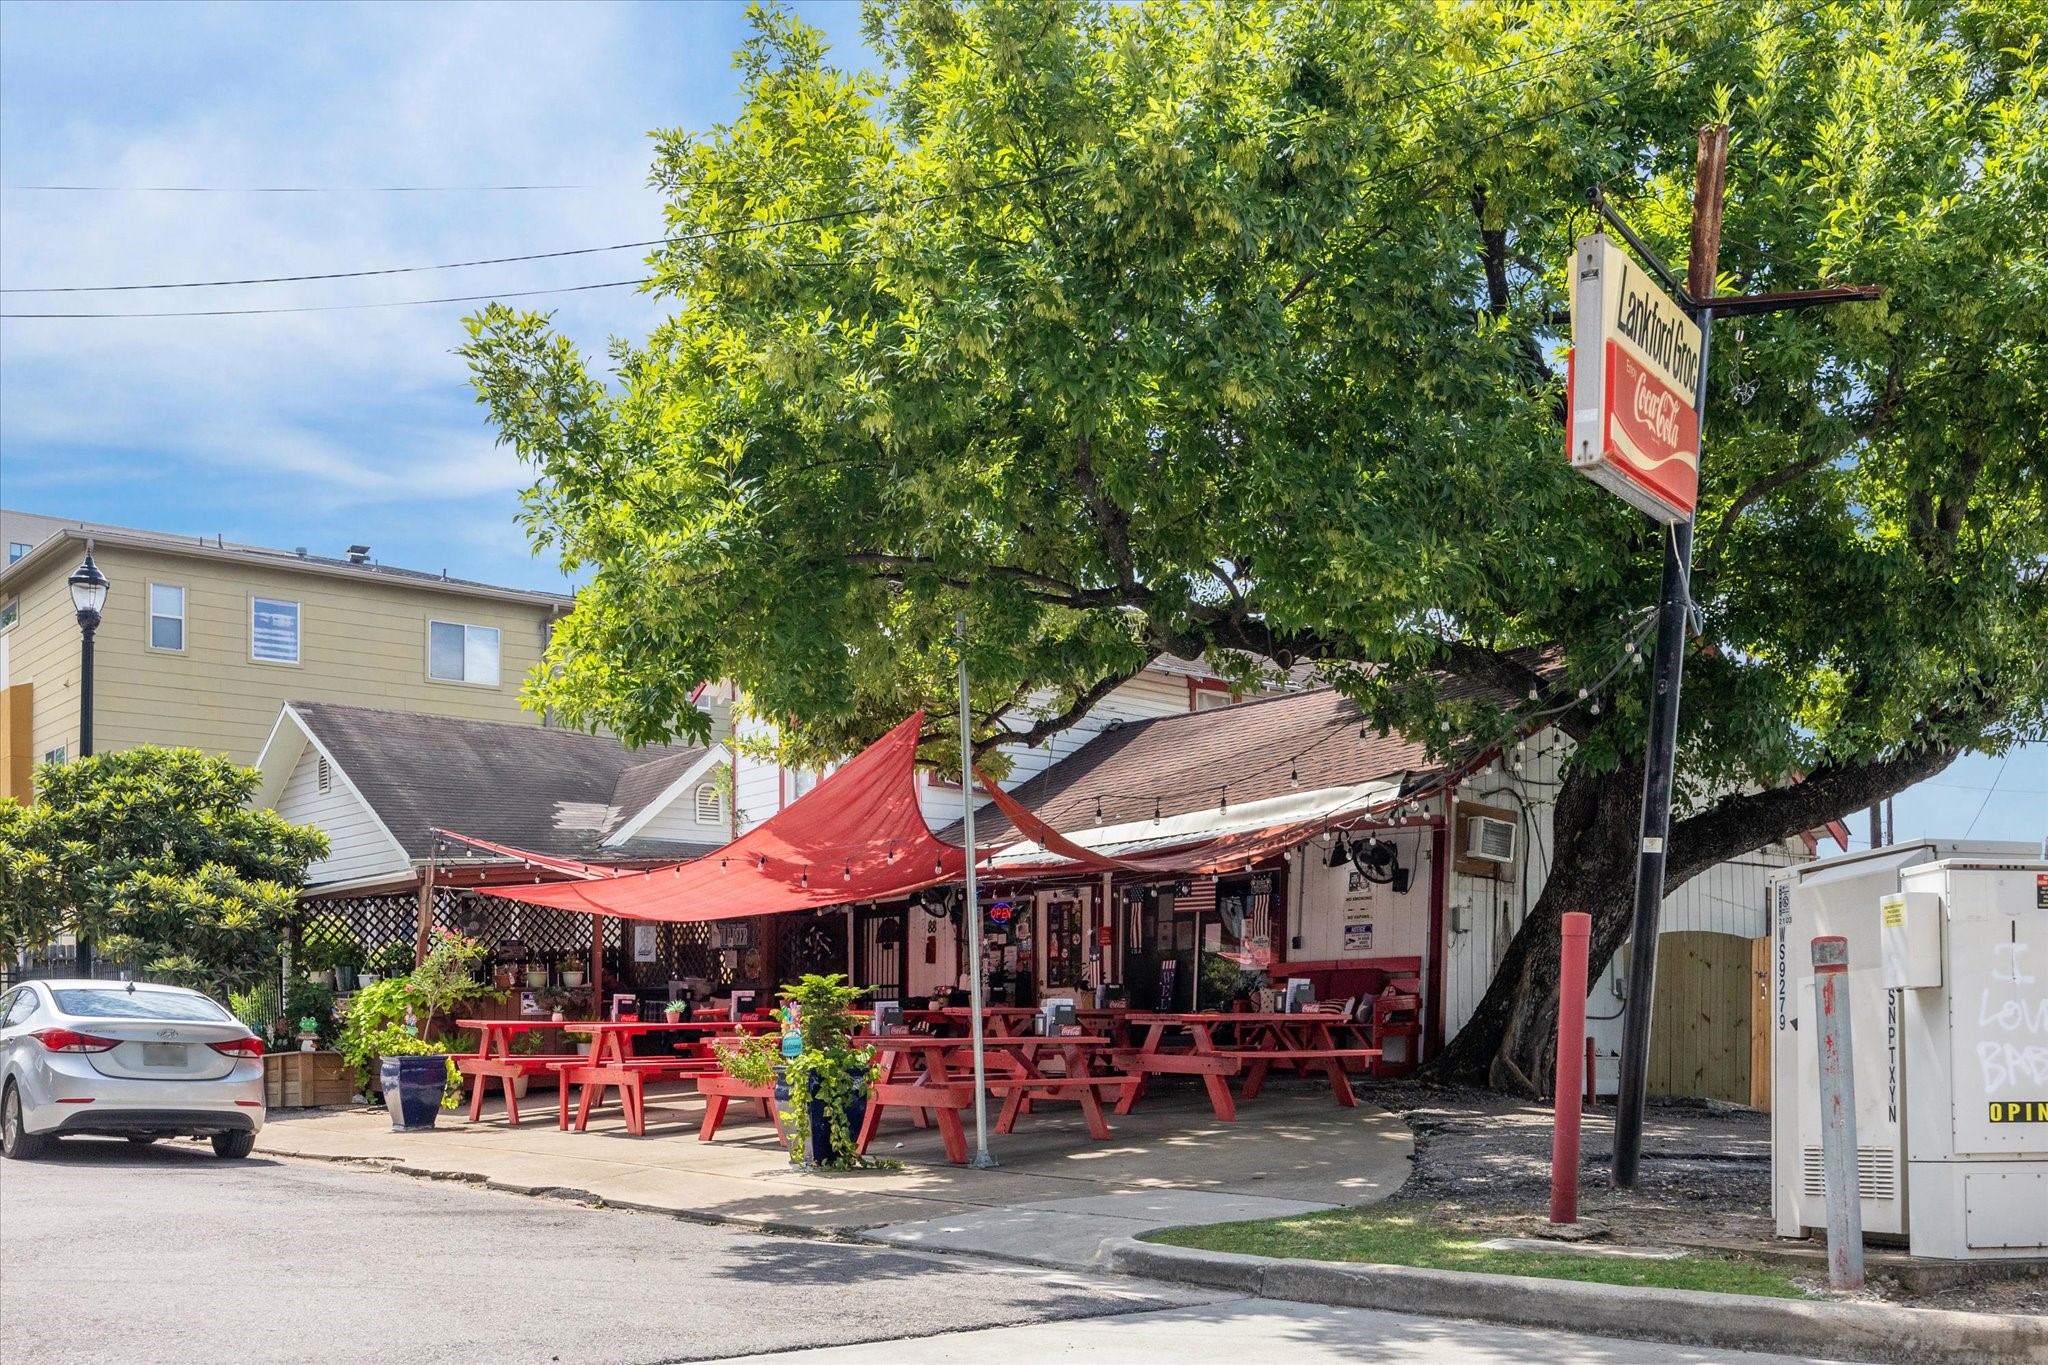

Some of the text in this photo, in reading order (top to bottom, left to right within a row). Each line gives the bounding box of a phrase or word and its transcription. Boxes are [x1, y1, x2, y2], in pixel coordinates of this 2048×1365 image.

[1617, 265, 1673, 373] Lankford
[1634, 372, 1680, 448] Coca-Cola
[990, 907, 1012, 920] OPEN
